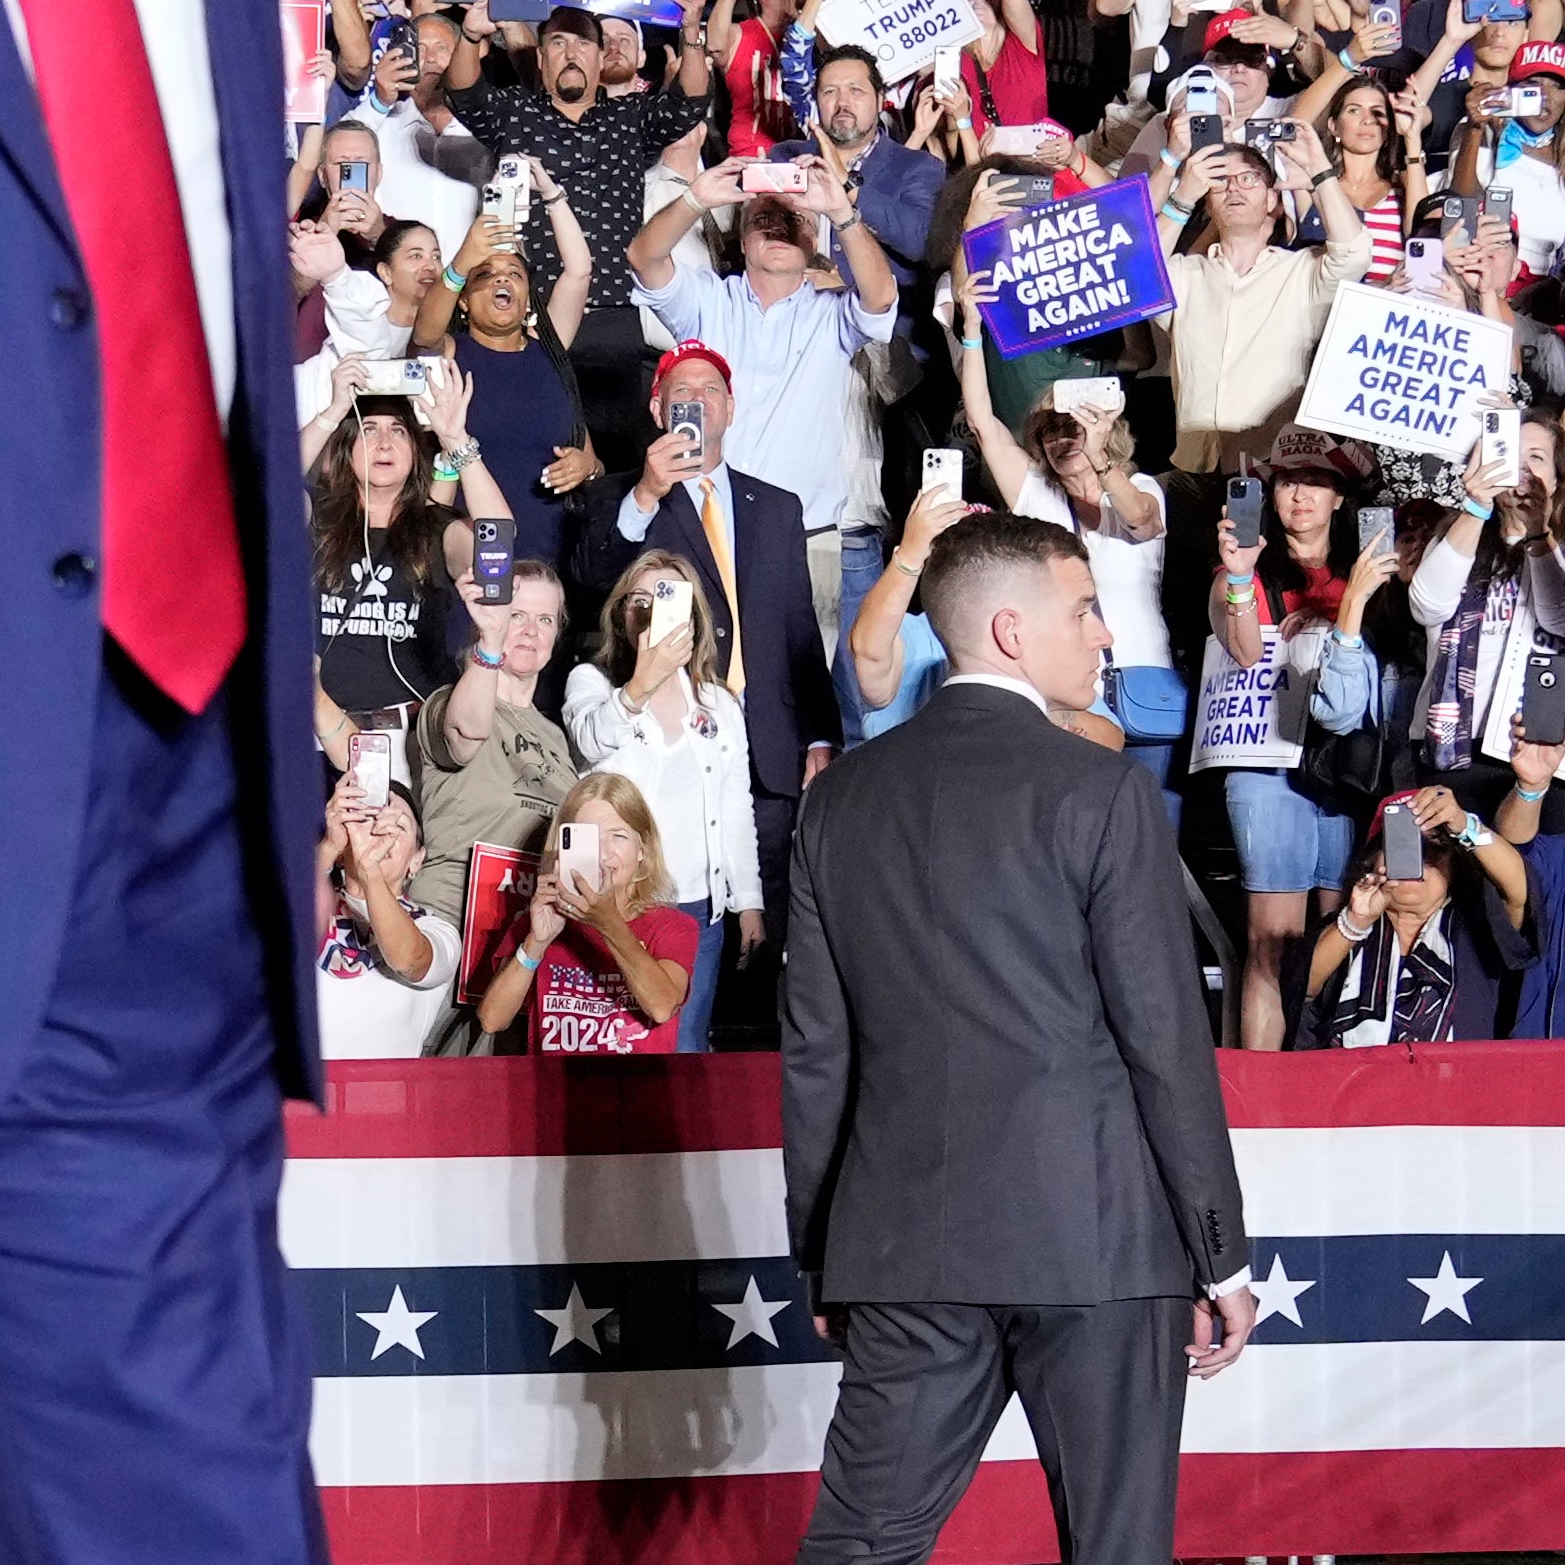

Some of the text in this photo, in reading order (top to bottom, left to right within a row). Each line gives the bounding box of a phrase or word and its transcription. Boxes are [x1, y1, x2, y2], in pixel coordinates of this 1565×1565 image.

[878, 7, 962, 62] O 88022
[1047, 61, 1092, 87] AGA
[1008, 202, 1101, 254] MAKE
[991, 222, 1134, 287] AMERICA
[1016, 252, 1118, 307] GREAT
[1027, 278, 1132, 334] AGAIN!
[1383, 310, 1471, 354] MAKE
[1346, 333, 1488, 389] AMERICA
[1358, 365, 1466, 411] GREAT
[1343, 392, 1458, 438] AGAIN!
[1278, 433, 1327, 446] ULTRA
[479, 551, 509, 562] TRUMP
[321, 593, 348, 616] MY
[349, 601, 386, 621] DOG
[388, 602, 408, 621] IS
[1203, 668, 1291, 698] AMERICA
[1206, 695, 1272, 722] GREAT
[1200, 722, 1269, 750] AGAIN!
[545, 996, 619, 1016] TAKE AMERIC
[541, 1014, 618, 1054] 2024
